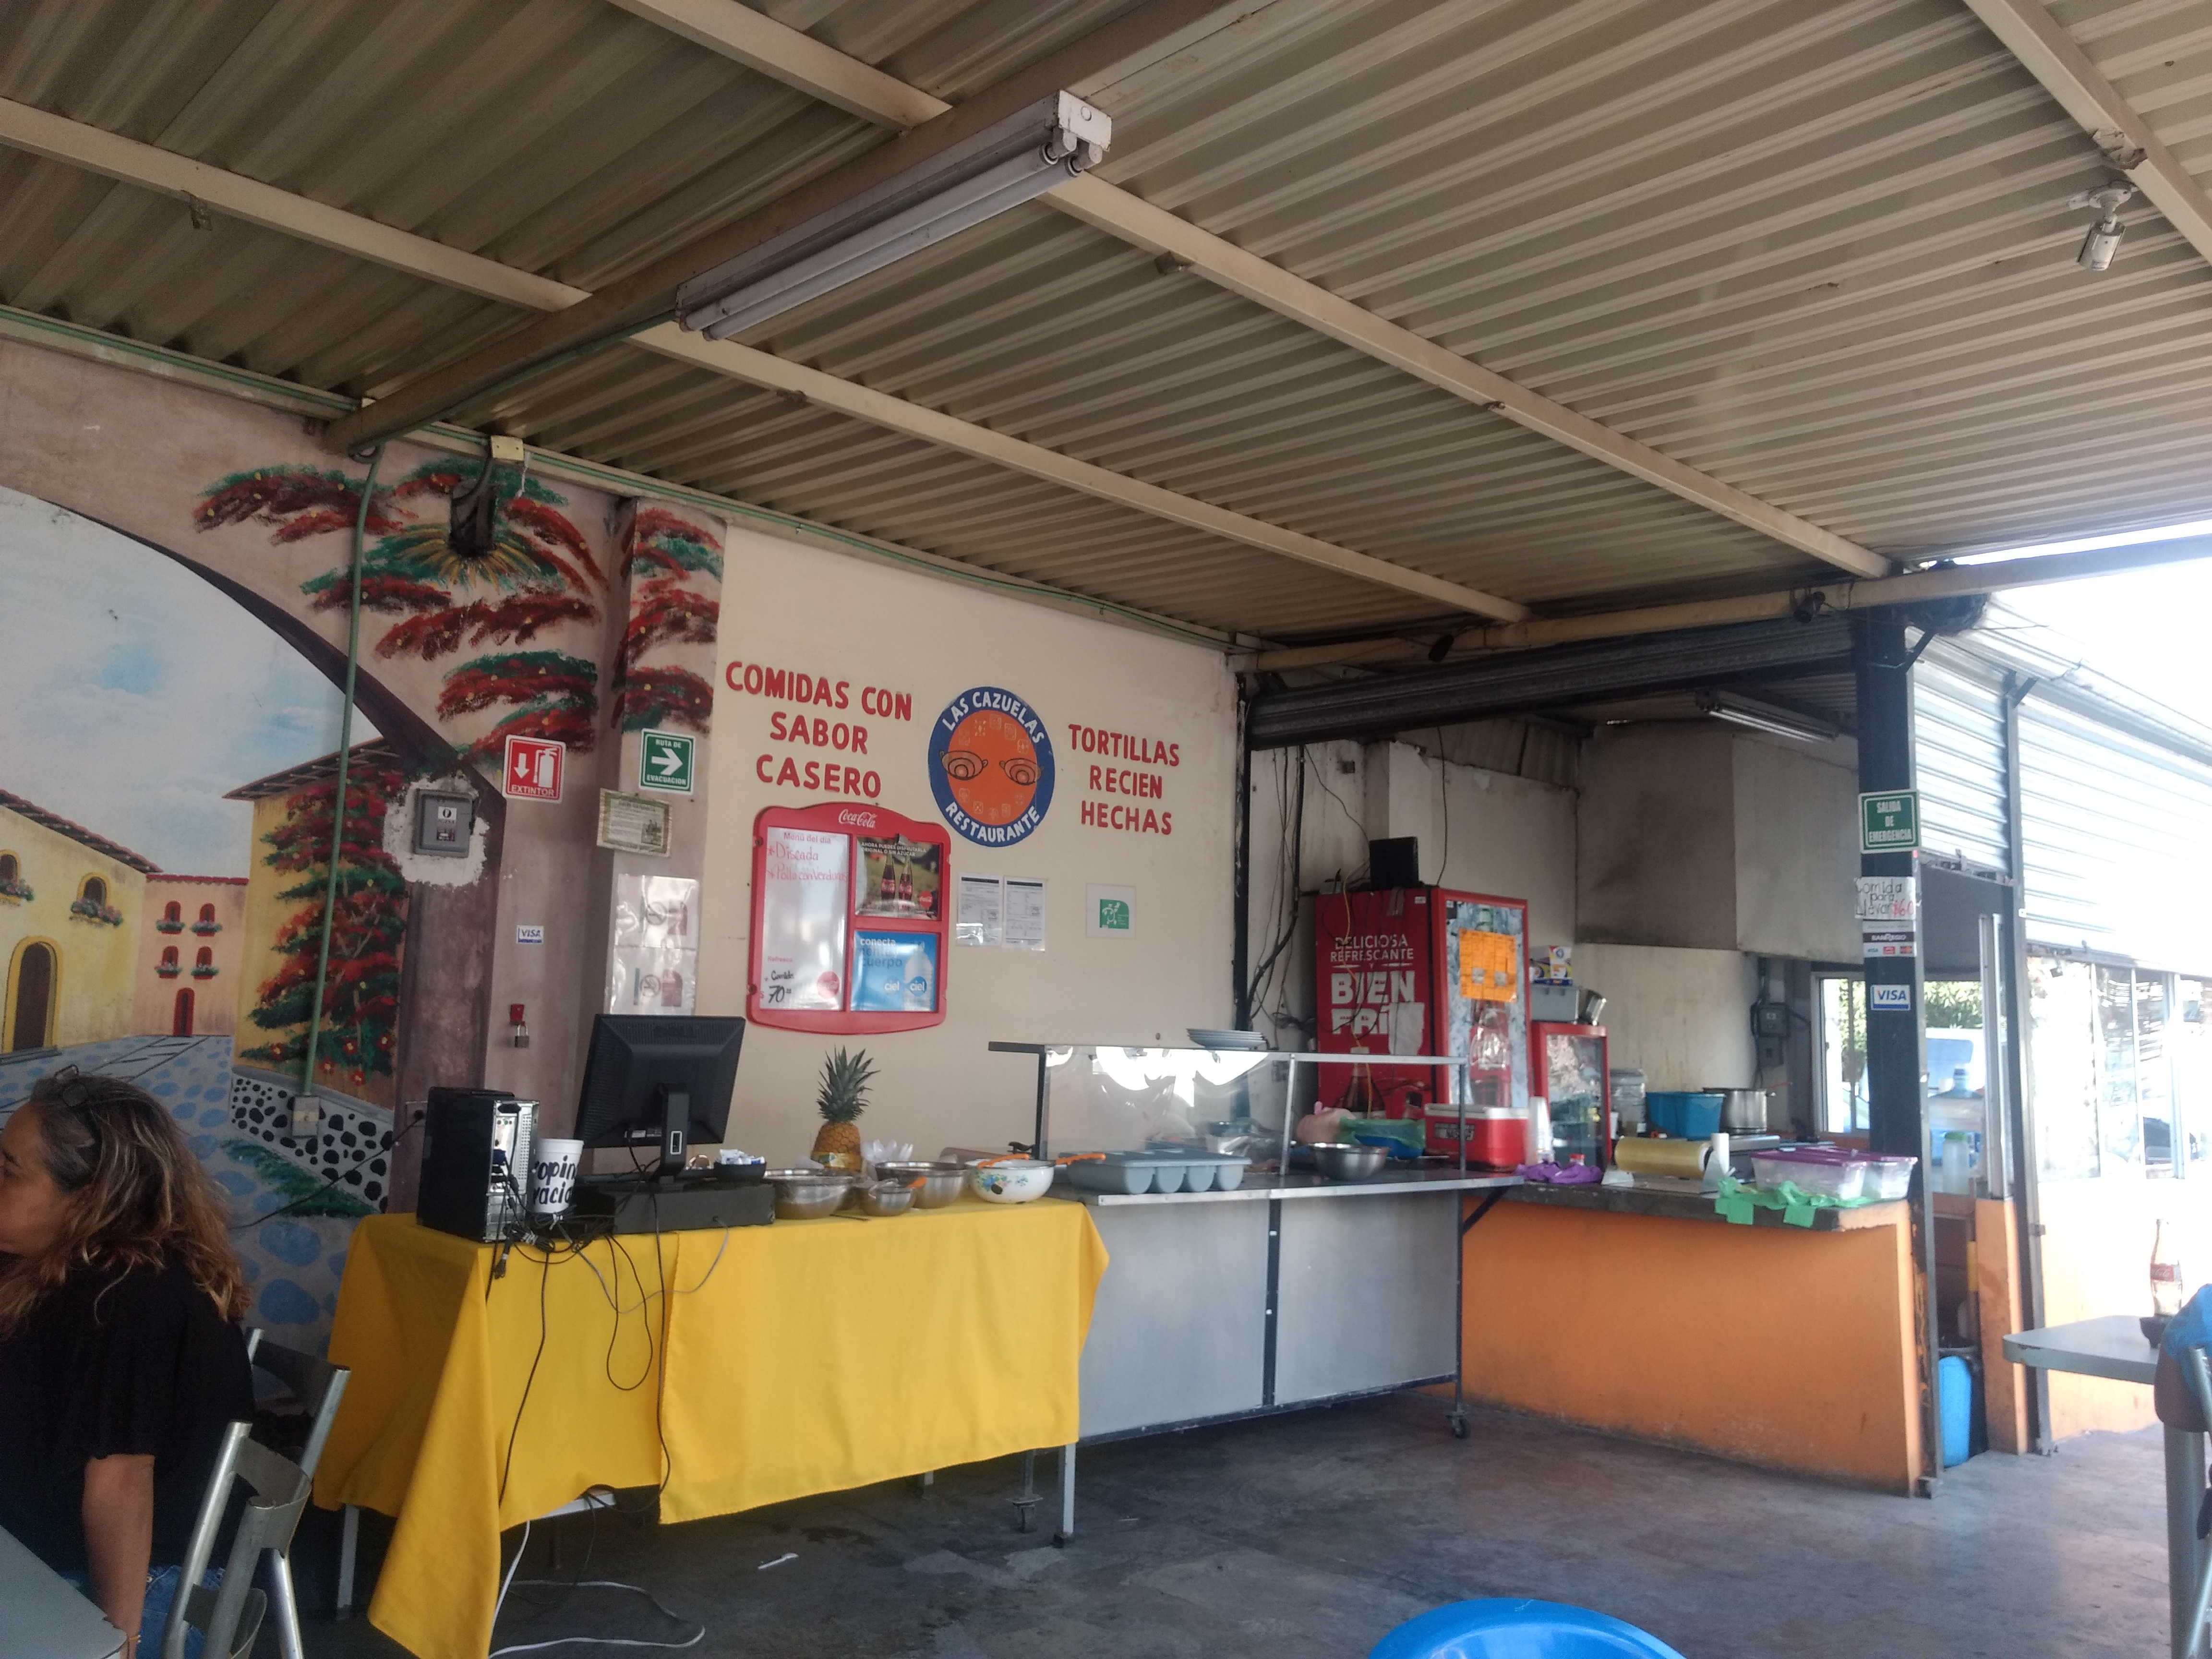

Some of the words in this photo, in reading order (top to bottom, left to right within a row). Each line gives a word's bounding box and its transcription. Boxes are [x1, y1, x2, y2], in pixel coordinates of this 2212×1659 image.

[726, 661, 850, 709] COMIDAS
[862, 686, 912, 721] CON
[942, 698, 969, 731] LAS
[973, 692, 1045, 744] CAZUELAS
[770, 711, 868, 754] SABOR
[655, 739, 672, 747] RUTA
[1068, 723, 1180, 767] TORTILLAS
[647, 774, 686, 785] EVACUACION
[756, 754, 882, 798] CASERO
[1090, 765, 1162, 799] RECIEN
[511, 783, 554, 797] EXTINTOR
[1876, 800, 1901, 813] SALIDA
[838, 808, 878, 829] Coca-Cola
[945, 802, 1040, 842] RESTAURANTE
[1082, 800, 1172, 835] HECHAS
[1885, 815, 1894, 827] DE
[806, 834, 818, 842] del
[776, 841, 818, 861] Discada
[1870, 893, 1895, 907] para
[521, 929, 541, 938] VISA
[860, 938, 896, 946] conecta
[1335, 934, 1408, 950] DELICIOSA
[1330, 948, 1414, 962] REFRESCANTE
[884, 981, 900, 991] ciel
[910, 980, 925, 991] ciel
[1331, 971, 1415, 1004] BIEN
[1877, 990, 1907, 1000] VISA
[1331, 1004, 1390, 1034] FRÍ
